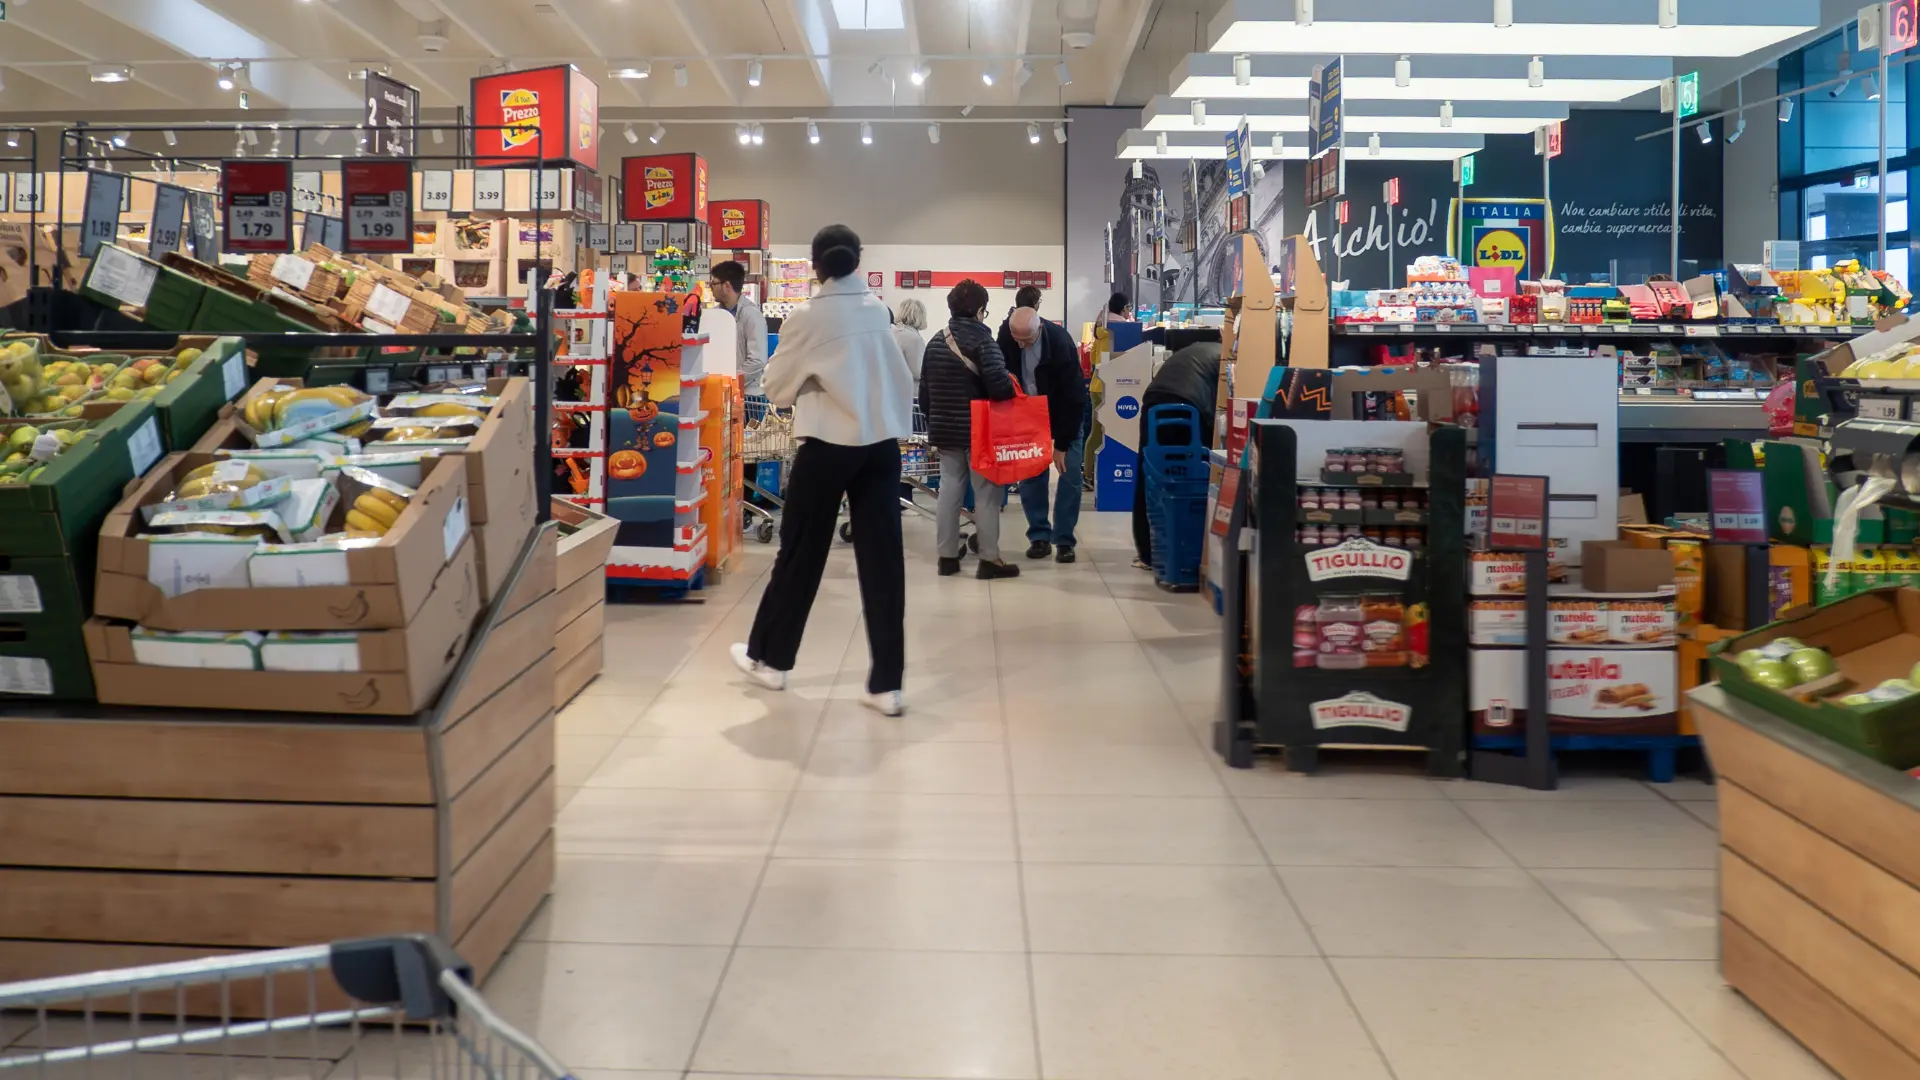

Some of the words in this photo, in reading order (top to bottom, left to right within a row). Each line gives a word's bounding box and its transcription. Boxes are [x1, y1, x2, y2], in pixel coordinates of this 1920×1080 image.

[1896, 5, 1908, 43] 6
[1683, 80, 1692, 109] 5
[368, 97, 377, 127] 2
[503, 107, 539, 123] Prezzo
[646, 180, 674, 190] Prezzo
[427, 191, 448, 200] 3.89
[478, 191, 499, 200] 3.99
[1471, 206, 1531, 217] ITALIA
[1560, 200, 1586, 217] Non
[1588, 202, 1641, 217] cambiare
[1690, 202, 1718, 219] vita,
[92, 219, 111, 237] 1.19
[723, 218, 745, 227] Prezzo
[1561, 219, 1603, 234] cambia
[241, 223, 273, 237] 1.79
[361, 223, 394, 237] 1.99
[156, 230, 177, 246] 2.99
[592, 238, 607, 246] 2.39
[670, 237, 686, 245] 0.45
[1117, 404, 1138, 412] NIVEA
[1882, 406, 1897, 418] 1.99
[1311, 552, 1404, 571] TIGULLIO
[1554, 612, 1597, 623] nutella
[1620, 612, 1664, 624] nutella
[1547, 656, 1622, 680] utella
[1316, 704, 1404, 723] TIGULLIO
